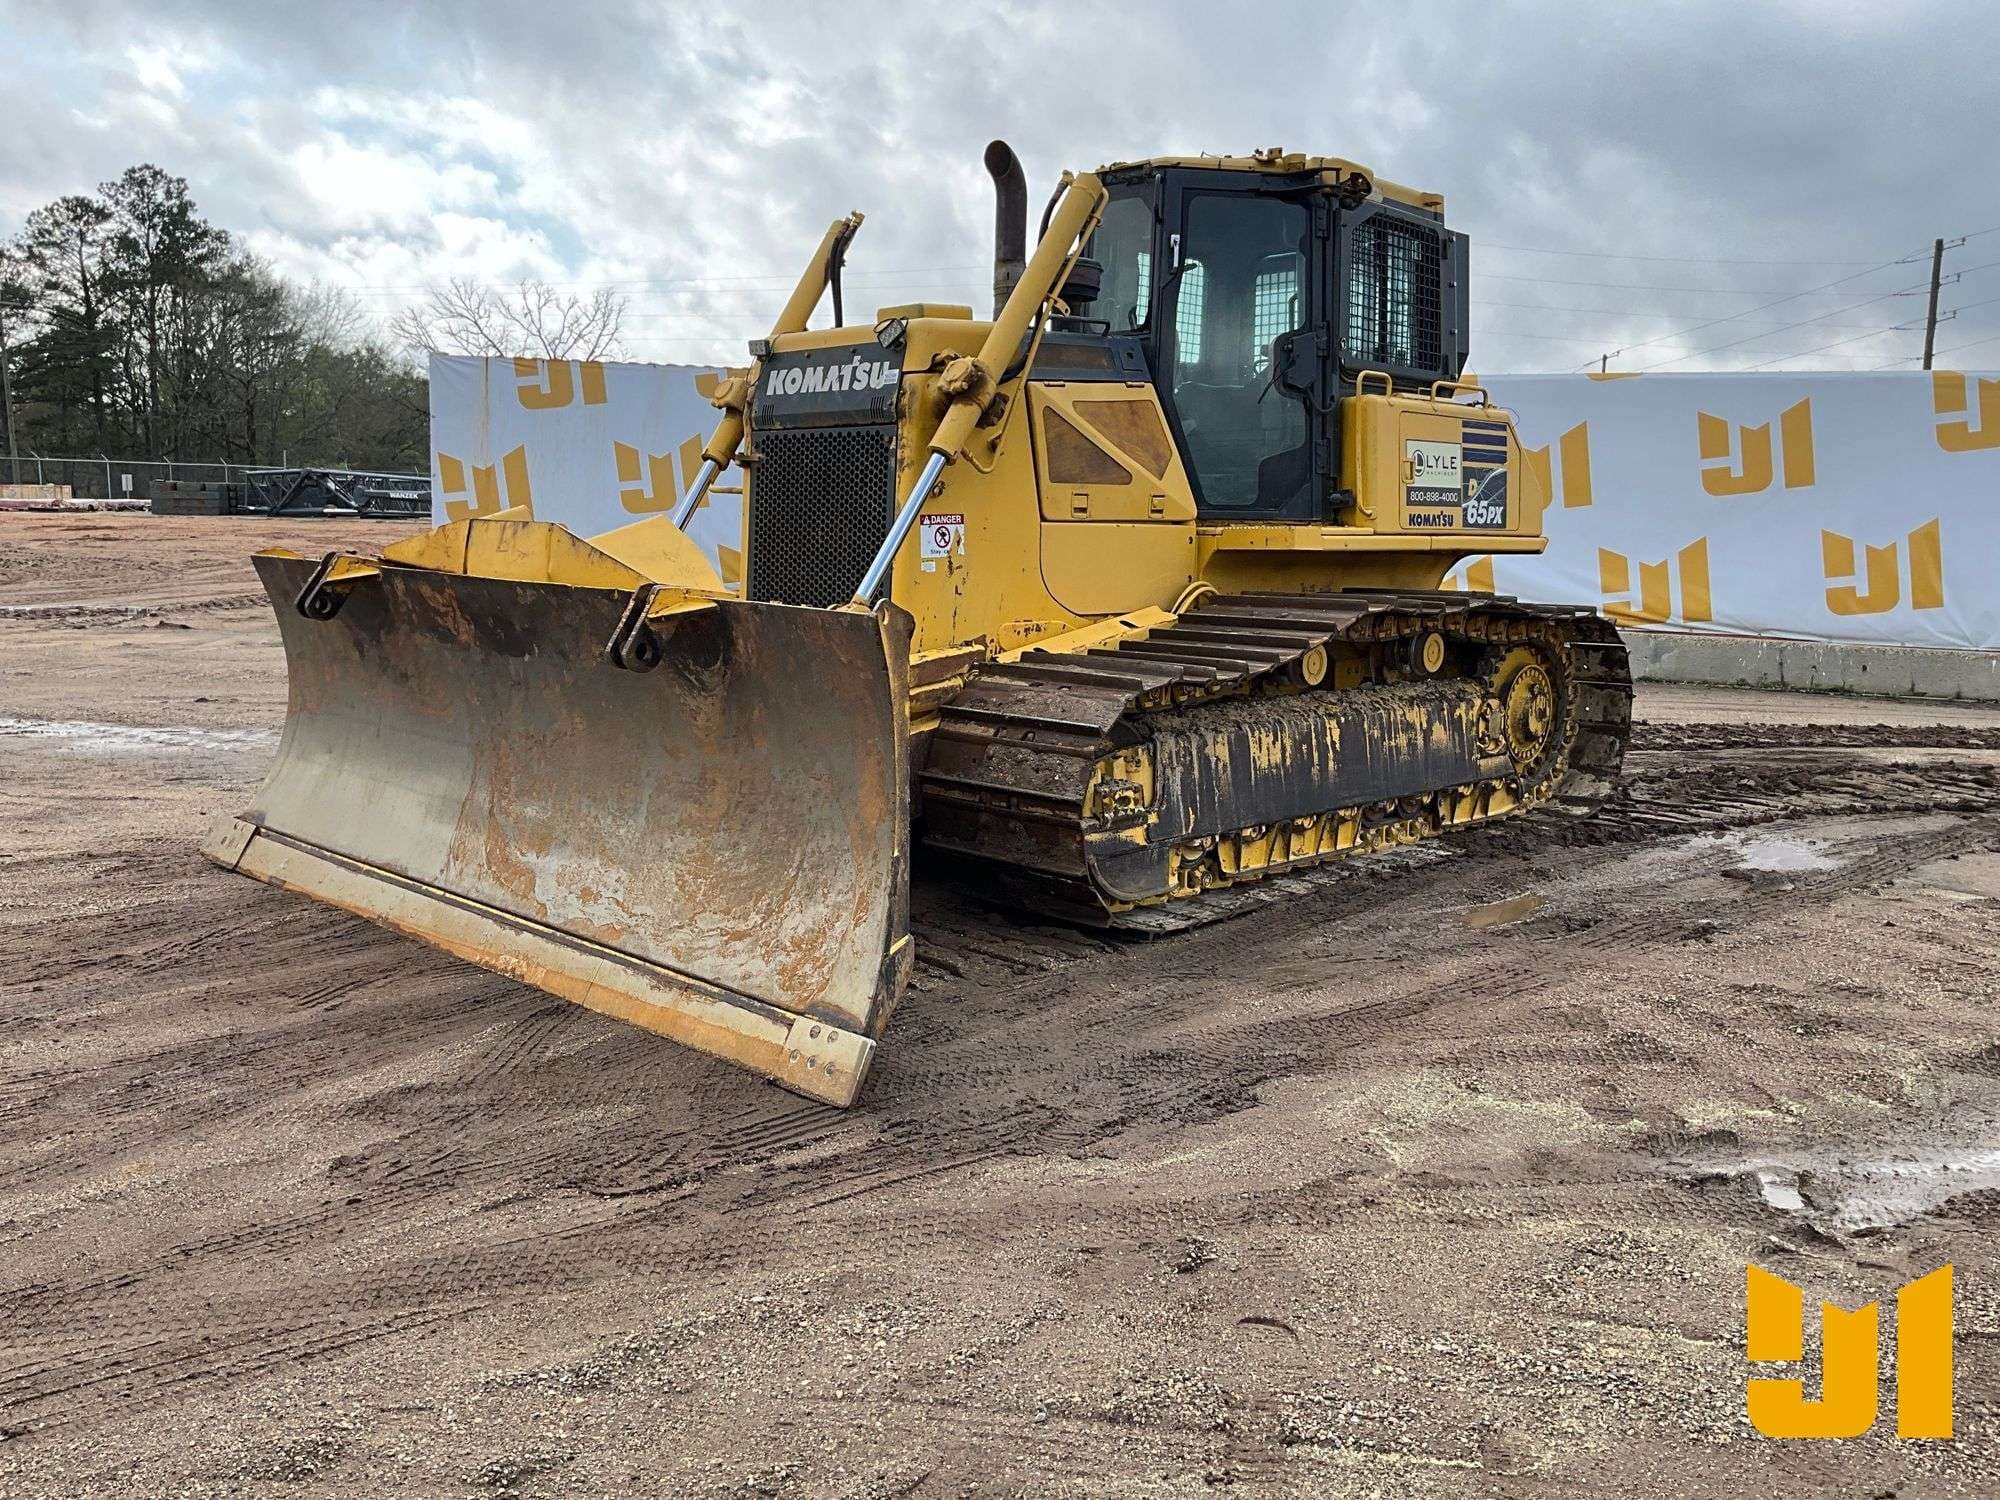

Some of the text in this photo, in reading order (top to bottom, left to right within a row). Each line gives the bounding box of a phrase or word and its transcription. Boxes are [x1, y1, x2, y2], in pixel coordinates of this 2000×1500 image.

[766, 355, 891, 396] KOMATSU
[1426, 455, 1457, 470] LYLE
[931, 515, 962, 524] DANGER
[1408, 511, 1454, 527] KOMATSU
[1467, 500, 1503, 524] 65PX
